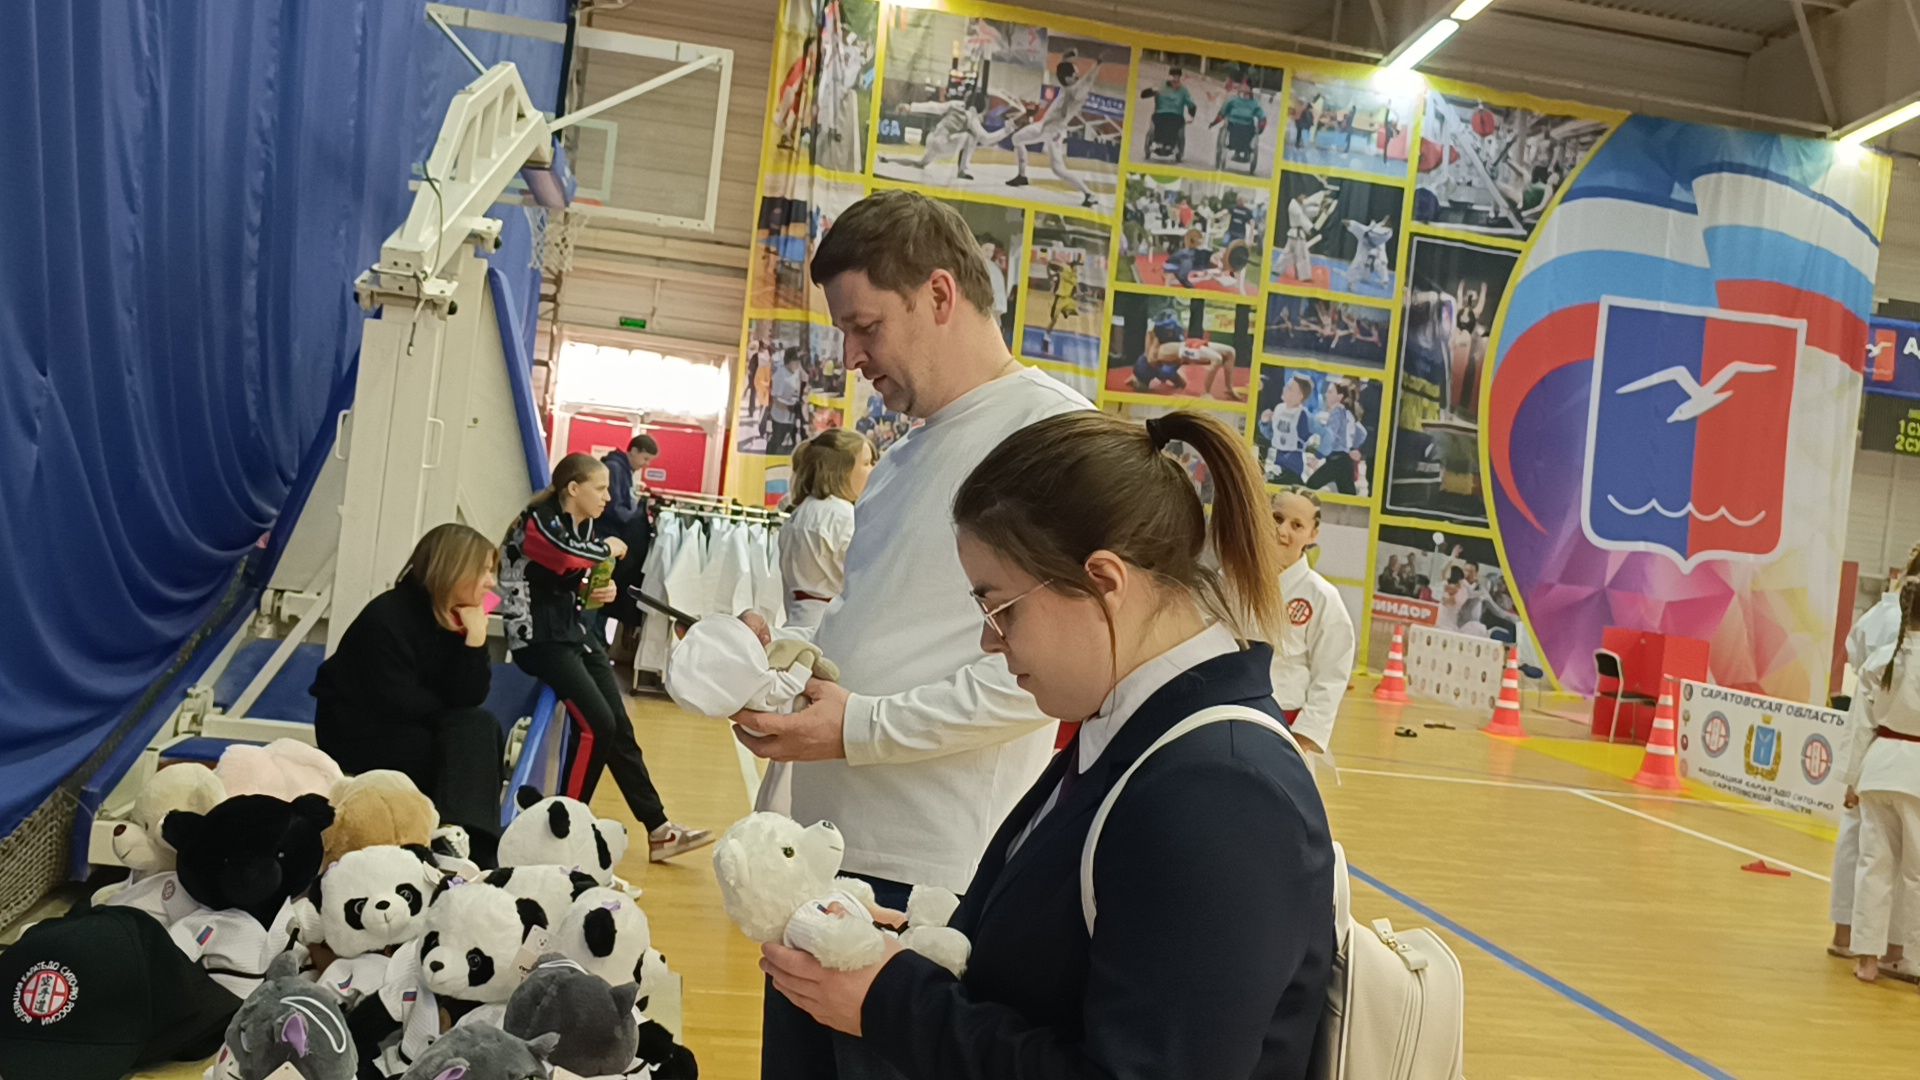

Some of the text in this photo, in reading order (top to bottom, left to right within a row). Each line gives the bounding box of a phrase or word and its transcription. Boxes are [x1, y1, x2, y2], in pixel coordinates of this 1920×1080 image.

[1701, 687, 1844, 726] САРАТОВСКАЯ ОБЛАСТЬ
[1712, 780, 1812, 815] САРАТОВСКОЙ ОБЛАСТИ
[41, 1001, 75, 1026] РОССИИ
